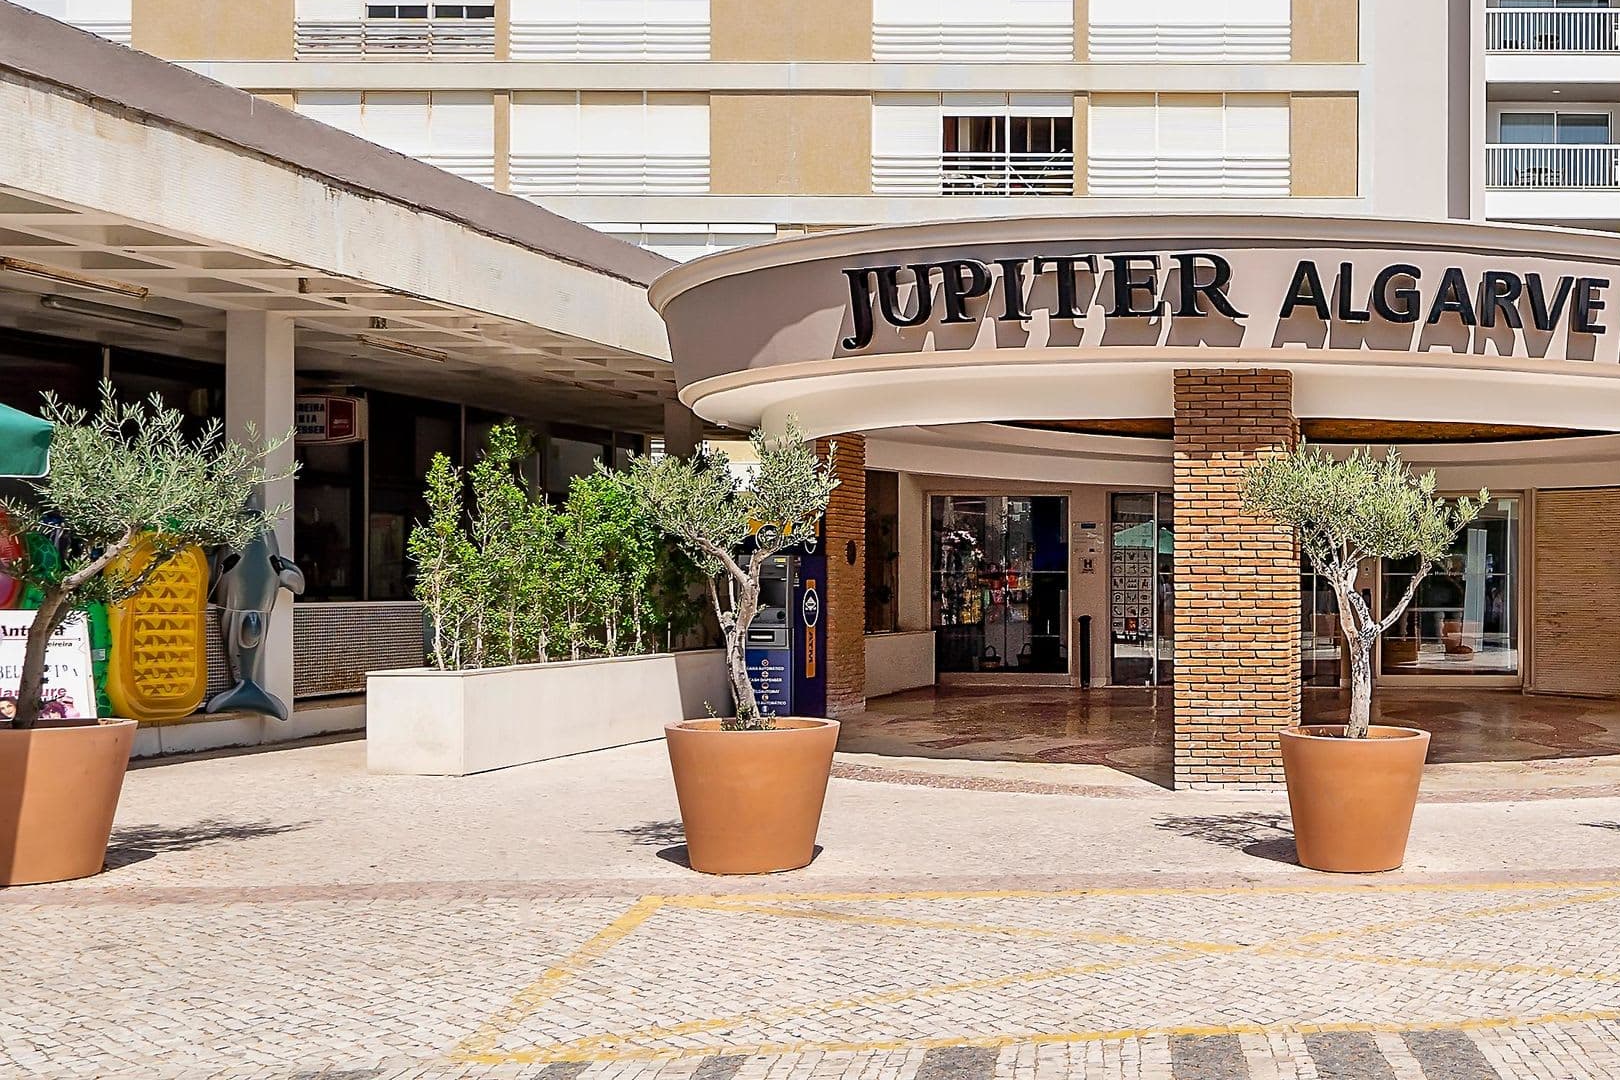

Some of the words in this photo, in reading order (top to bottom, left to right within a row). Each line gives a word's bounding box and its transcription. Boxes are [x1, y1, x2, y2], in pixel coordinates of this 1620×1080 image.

[842, 254, 1247, 350] JUPITER
[1280, 260, 1606, 333] ALGARVE
[0, 625, 66, 636] Anta
